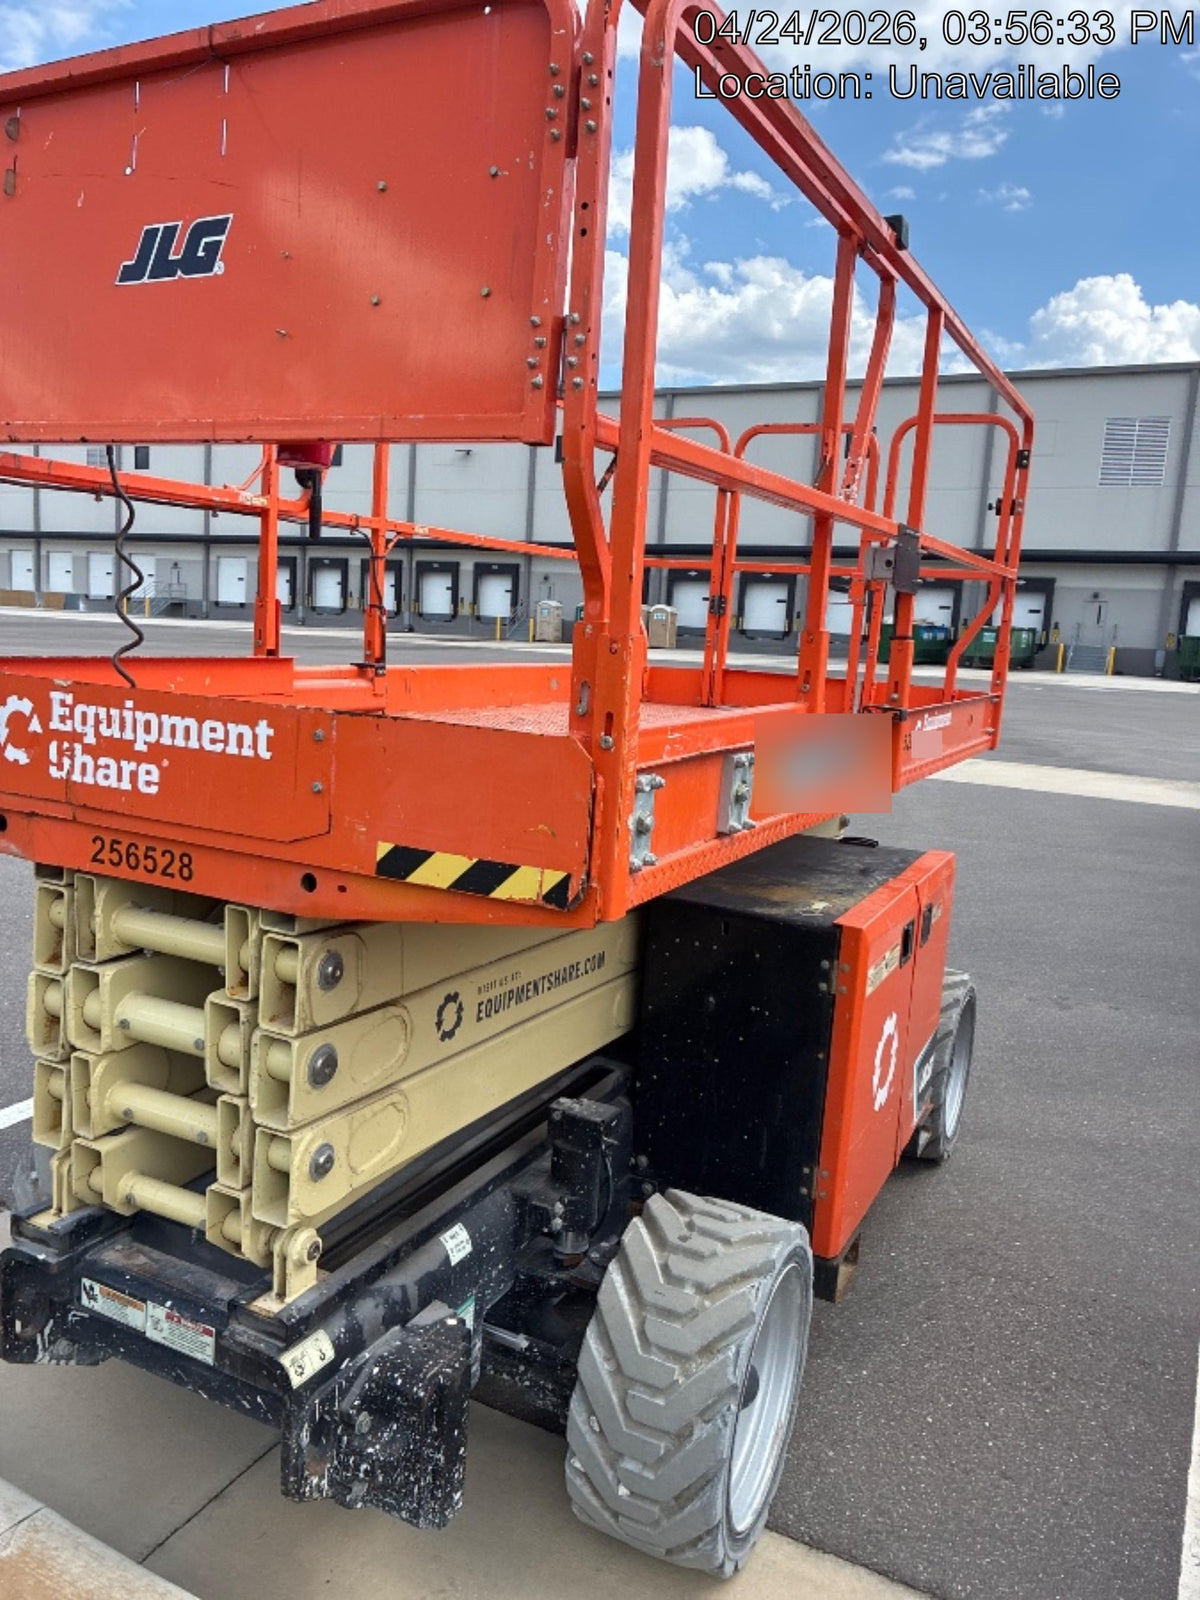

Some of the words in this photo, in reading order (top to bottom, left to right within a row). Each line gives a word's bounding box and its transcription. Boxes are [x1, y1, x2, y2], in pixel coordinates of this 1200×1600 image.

[115, 213, 234, 286] JLG
[49, 691, 274, 760] Equipment
[49, 740, 160, 794] Share
[90, 835, 194, 881] 256528
[476, 950, 606, 1023] EQUIPMENTSHARE.COM
